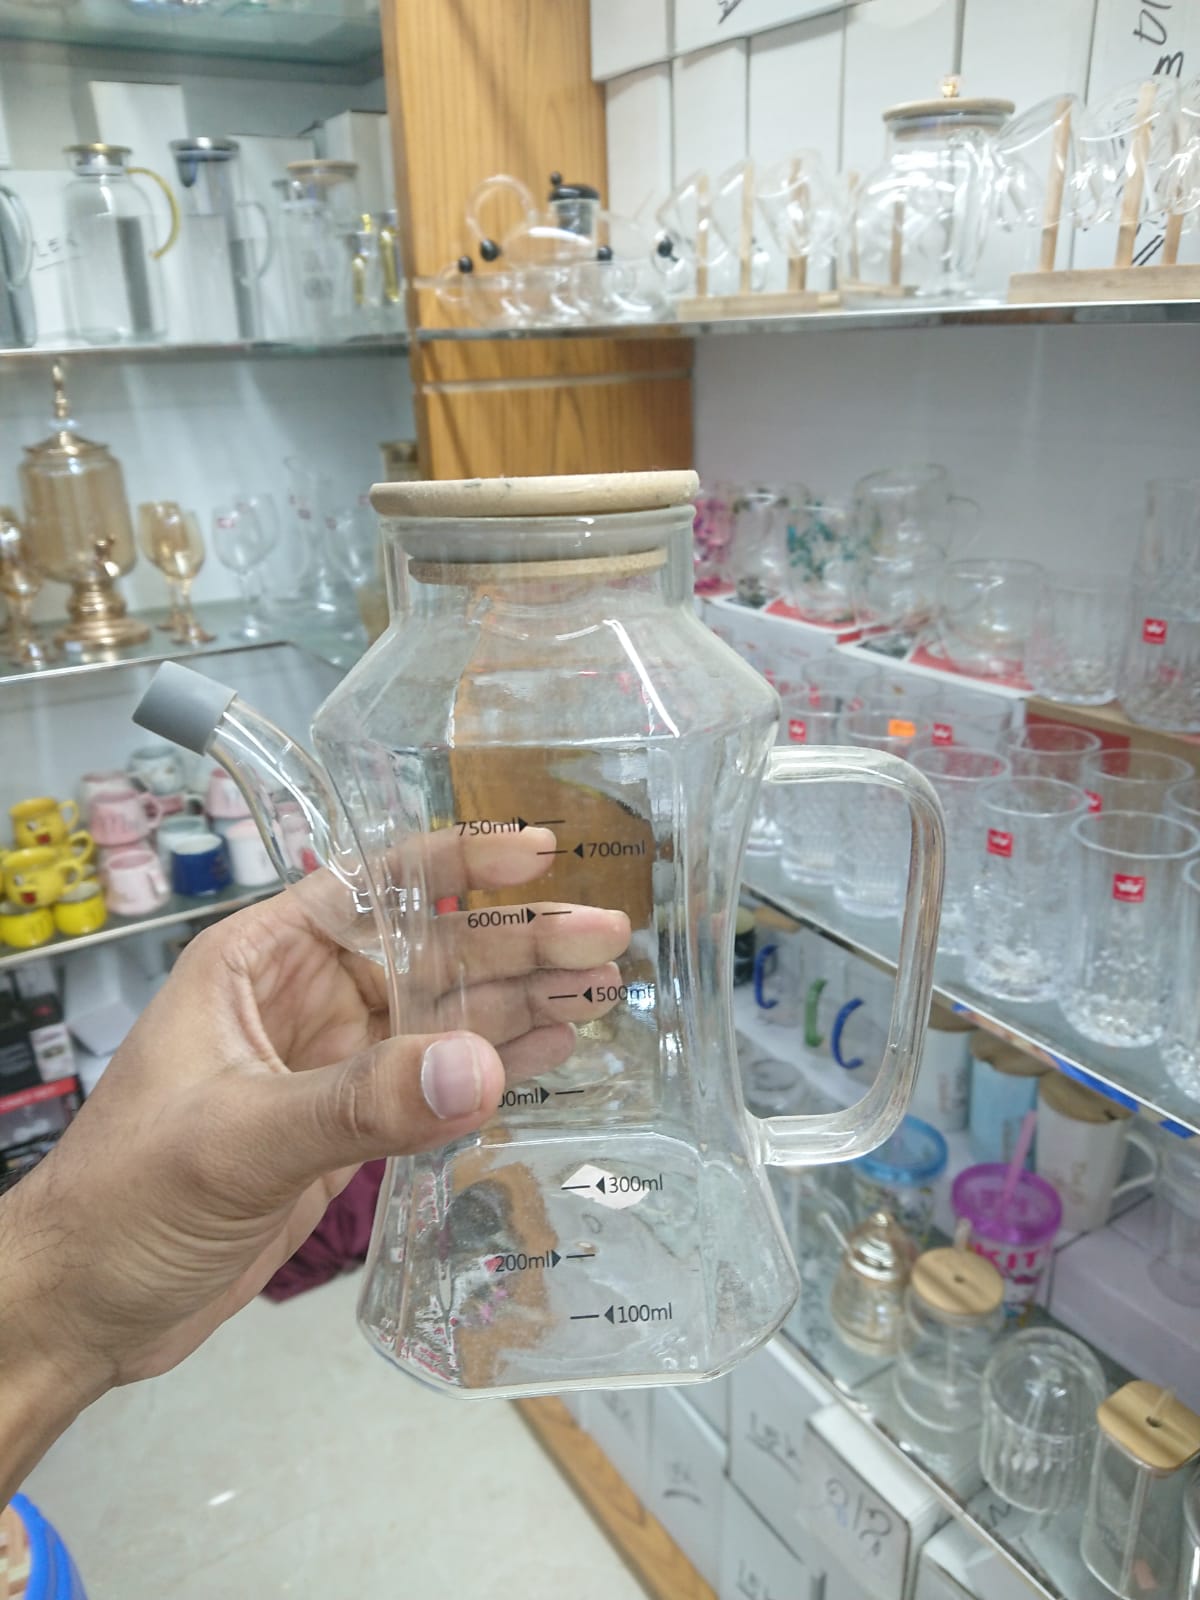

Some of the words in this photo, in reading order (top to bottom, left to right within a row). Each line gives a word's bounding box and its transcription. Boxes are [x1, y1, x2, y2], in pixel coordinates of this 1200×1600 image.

[456, 817, 516, 837] 750ml
[588, 840, 646, 858] 700ml
[468, 908, 524, 928] 600ml
[597, 985, 652, 1001] 500ml
[498, 1088, 539, 1108] 0ml
[608, 1174, 663, 1193] 300ml
[495, 1250, 550, 1272] 200ml
[618, 1303, 673, 1322] 100ml
